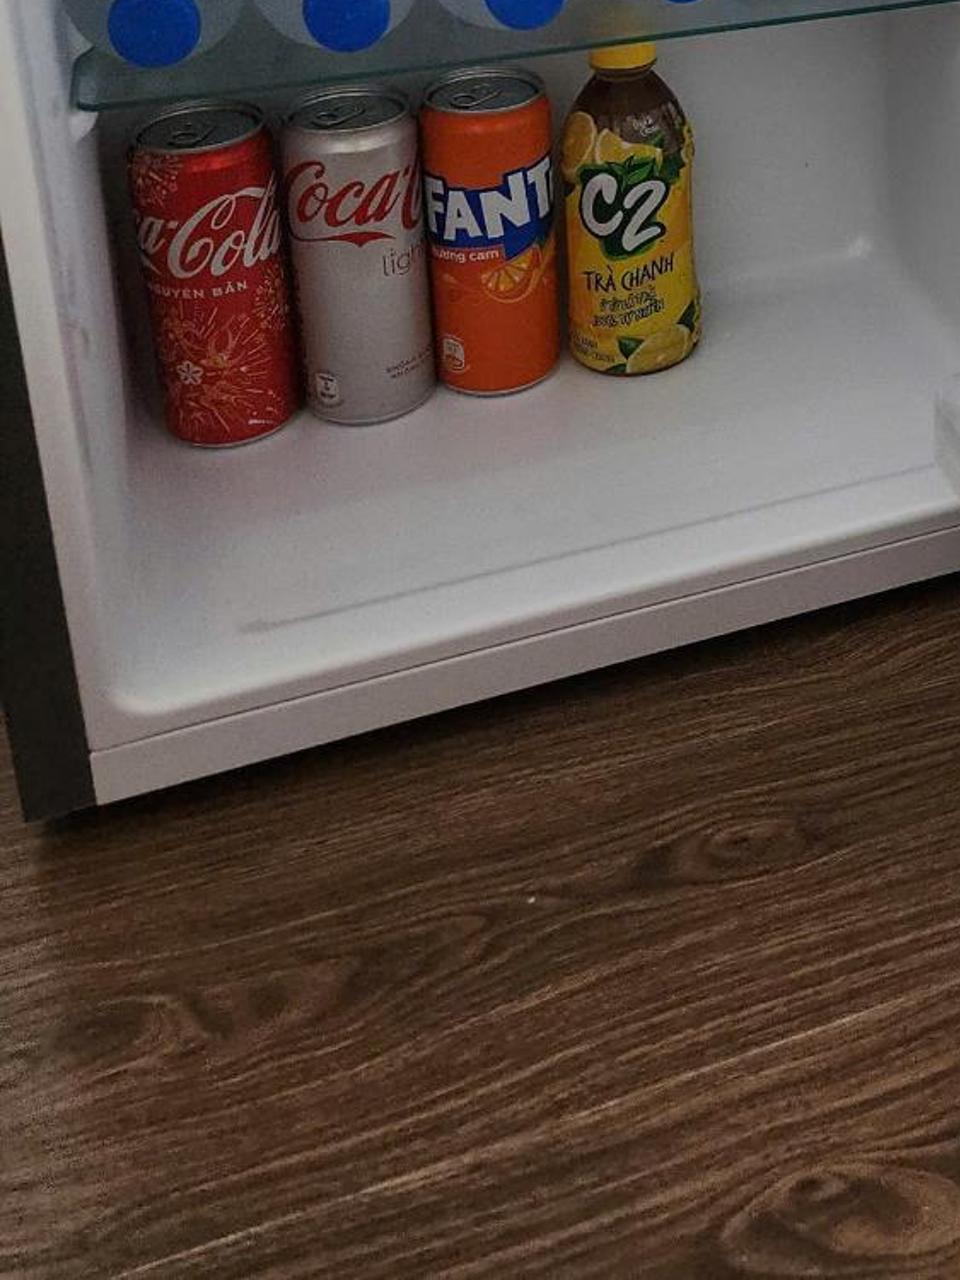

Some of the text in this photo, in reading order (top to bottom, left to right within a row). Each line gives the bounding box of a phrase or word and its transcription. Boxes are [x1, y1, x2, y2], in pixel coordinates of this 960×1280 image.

[424, 156, 554, 240] FANT
[581, 172, 667, 252] C2
[621, 251, 675, 291] CHANH
